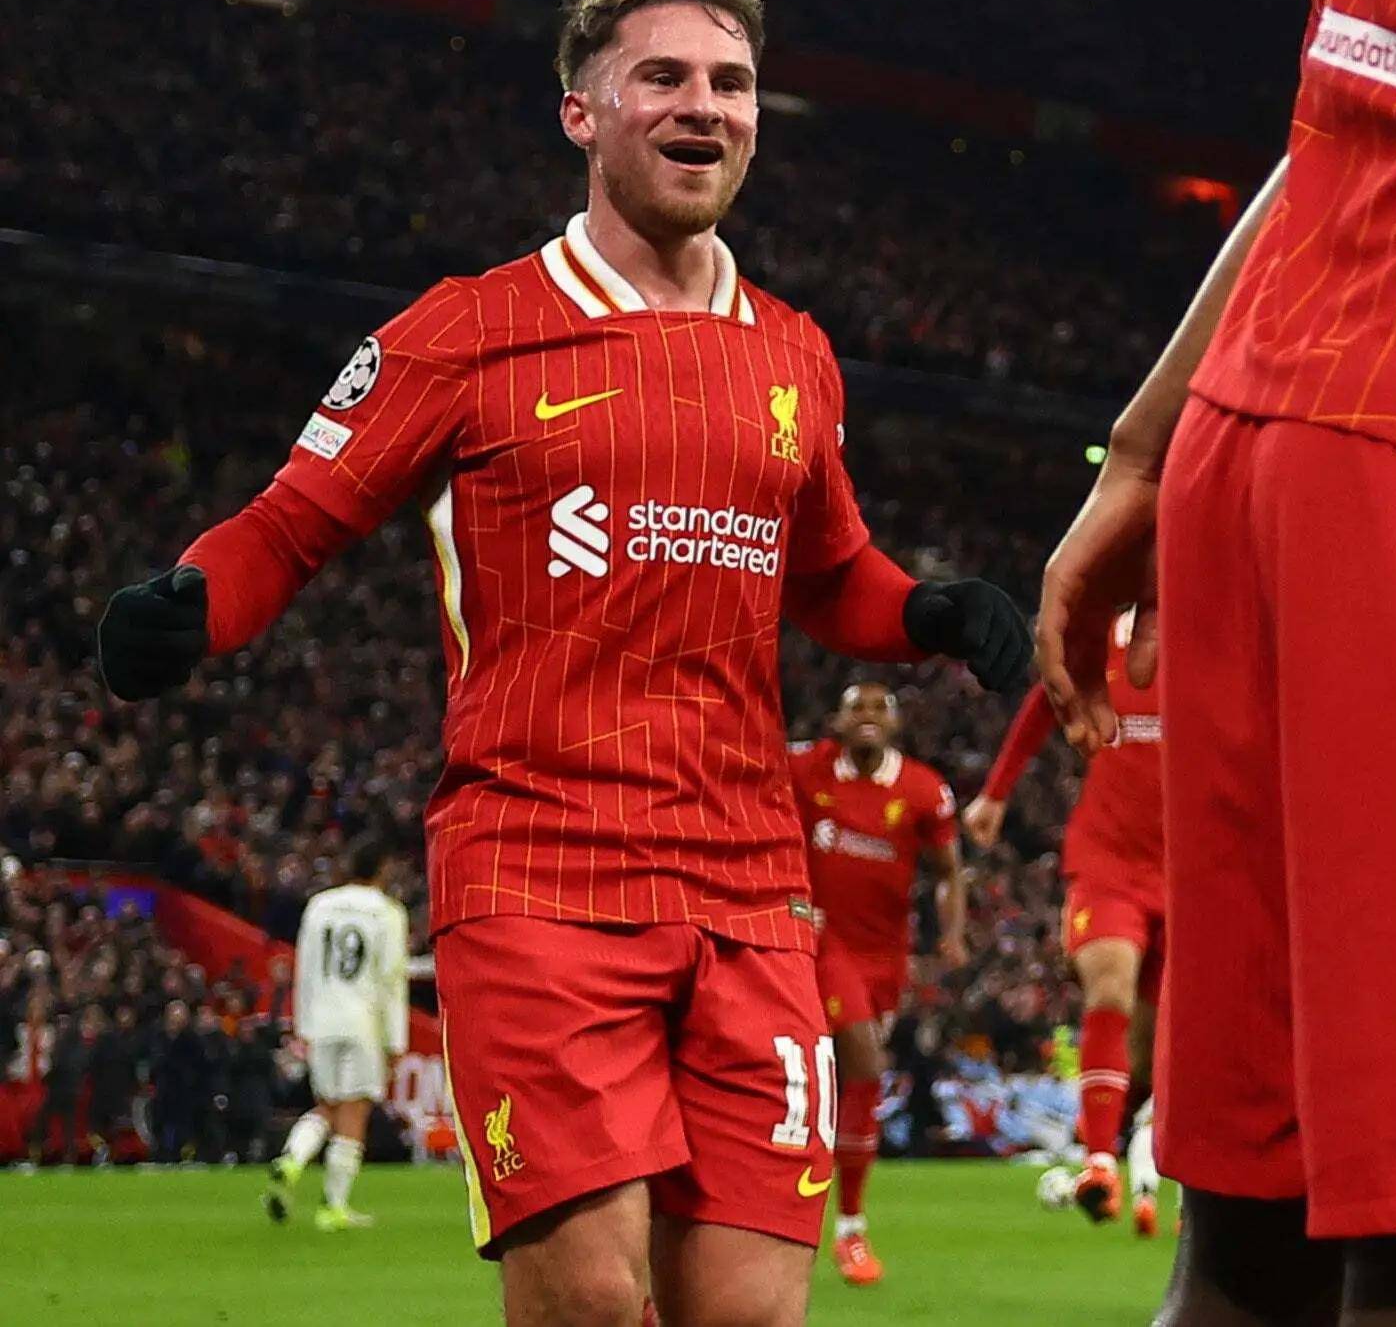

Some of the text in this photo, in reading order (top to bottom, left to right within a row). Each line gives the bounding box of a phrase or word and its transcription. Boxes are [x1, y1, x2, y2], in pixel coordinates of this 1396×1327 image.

[628, 500, 782, 545] standard
[627, 530, 780, 577] chartered
[771, 1035, 838, 1149] 10
